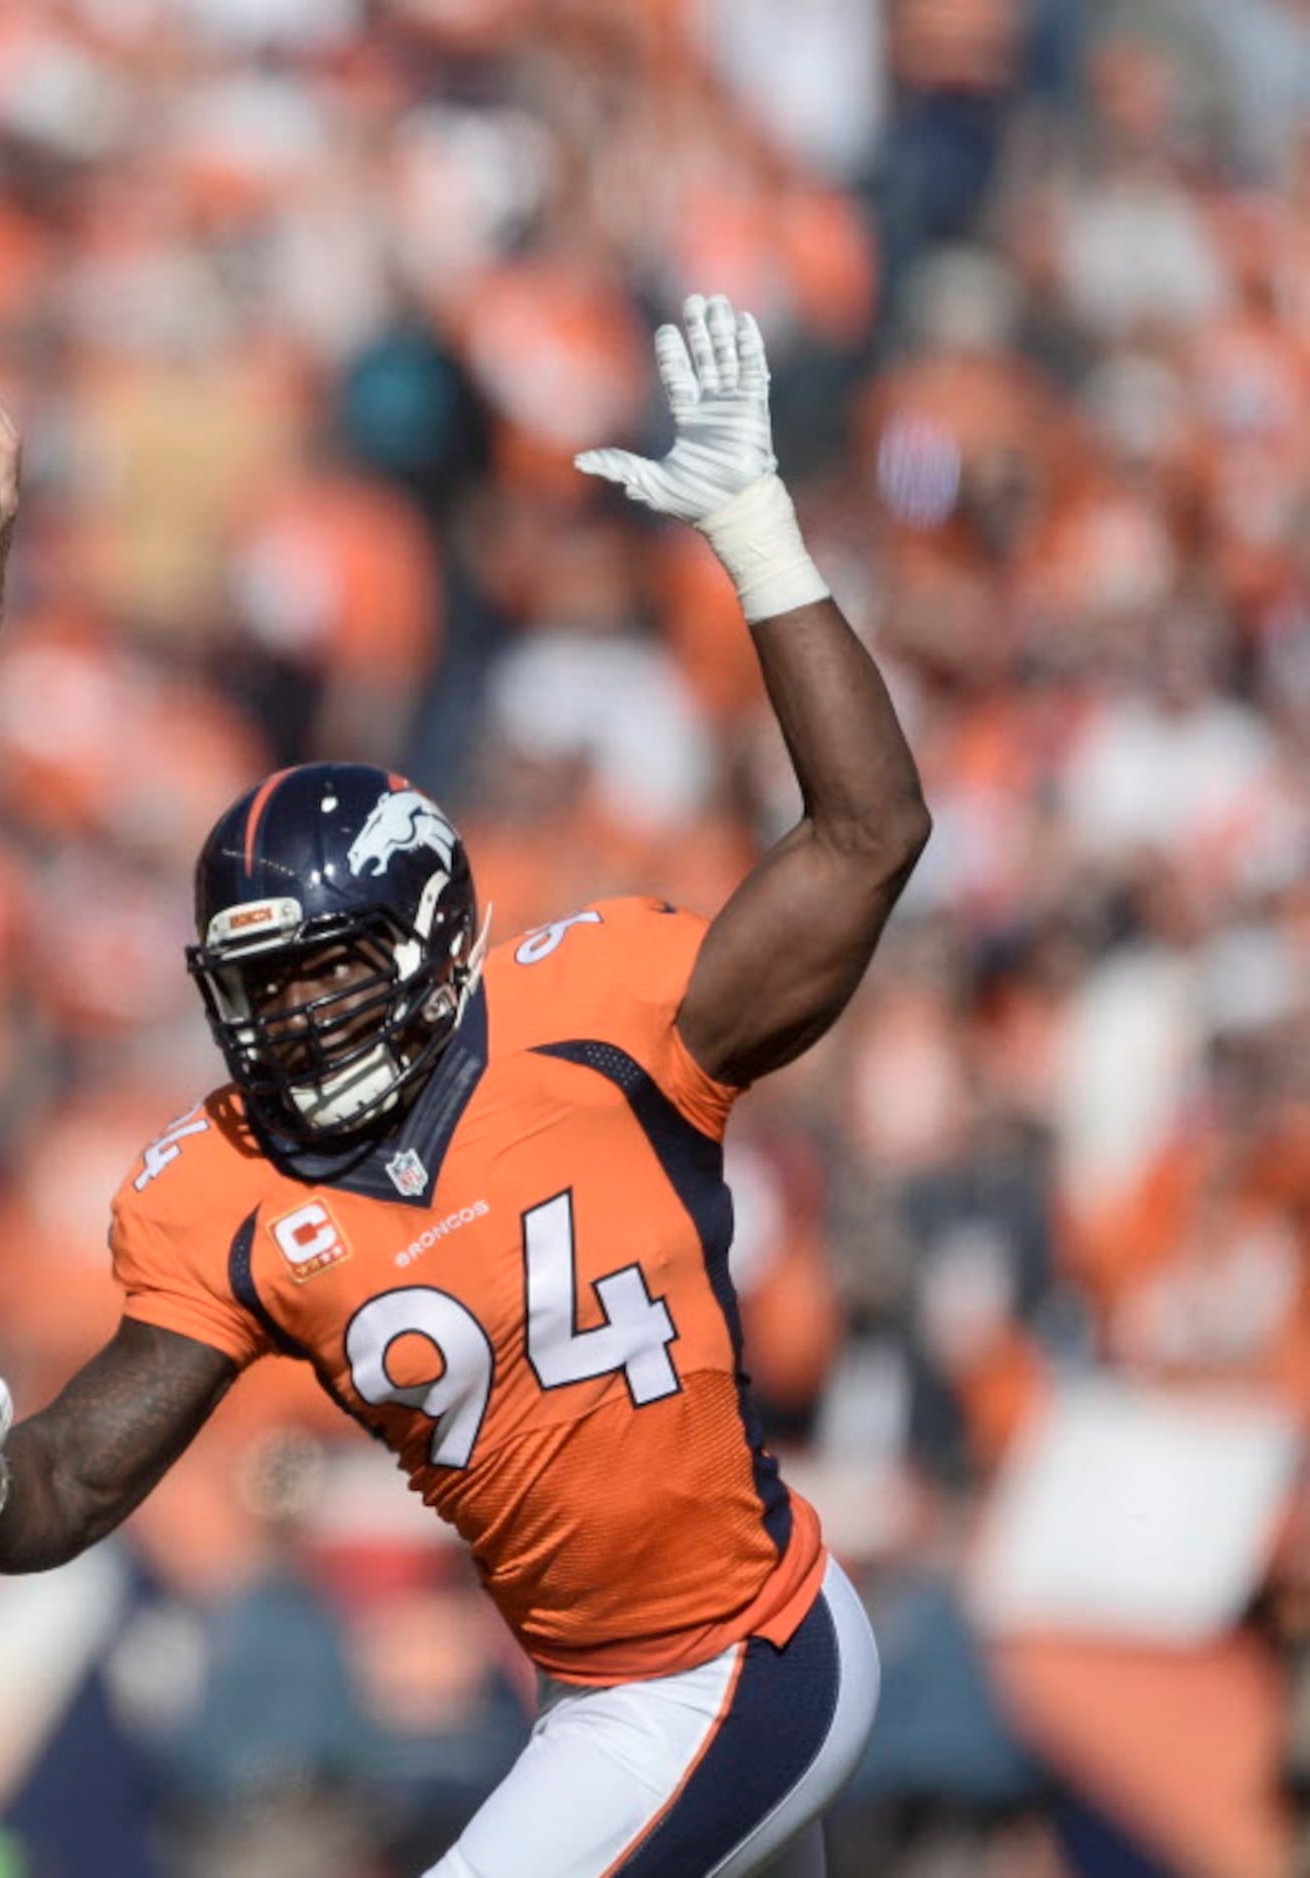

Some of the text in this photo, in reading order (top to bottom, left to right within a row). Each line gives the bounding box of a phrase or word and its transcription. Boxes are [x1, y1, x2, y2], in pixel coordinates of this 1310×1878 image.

[513, 909, 604, 966] 9
[274, 1203, 338, 1264] C
[395, 1200, 490, 1268] BRONCOS
[343, 1187, 683, 1469] 94
